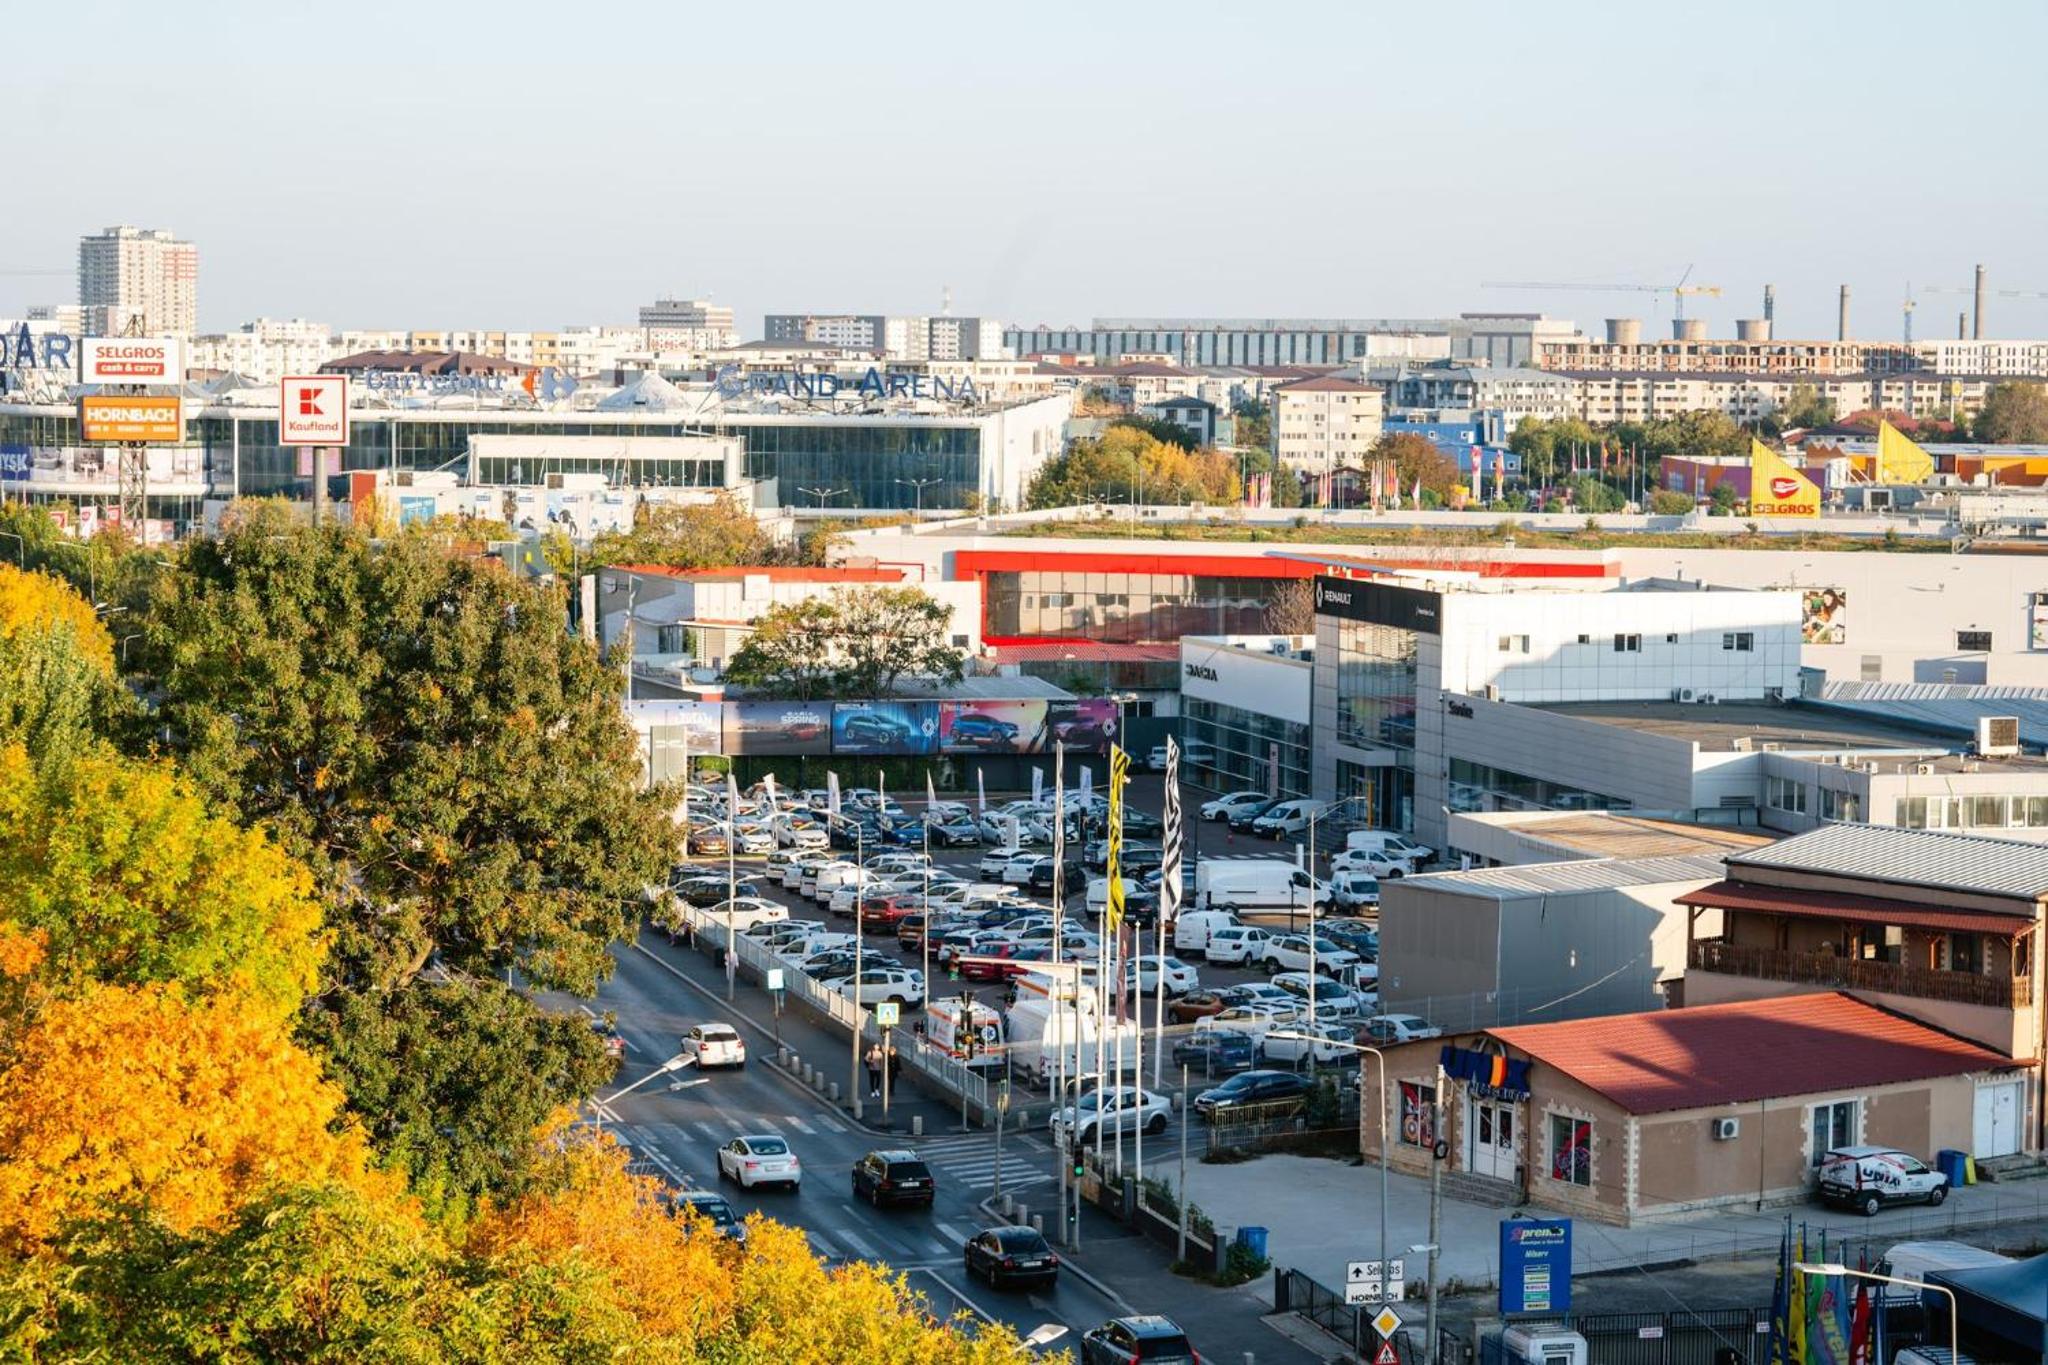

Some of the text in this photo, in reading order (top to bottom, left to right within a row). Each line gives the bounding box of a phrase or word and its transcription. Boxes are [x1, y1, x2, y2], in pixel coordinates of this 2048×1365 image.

[0, 322, 71, 368] AR
[96, 346, 165, 358] SELGROS
[101, 364, 123, 372] cash
[134, 365, 160, 374] carry
[716, 366, 978, 398] GRAND ARENA
[87, 408, 175, 422] HORNBACH
[289, 421, 339, 431] Kaufland
[0, 453, 28, 471] YSK
[1753, 503, 1815, 515] SELGROS
[1325, 590, 1352, 605] RENAULT
[1185, 664, 1218, 682] DACIA
[1367, 1264, 1401, 1276] Selos
[1351, 1292, 1399, 1302] HORNBCH
